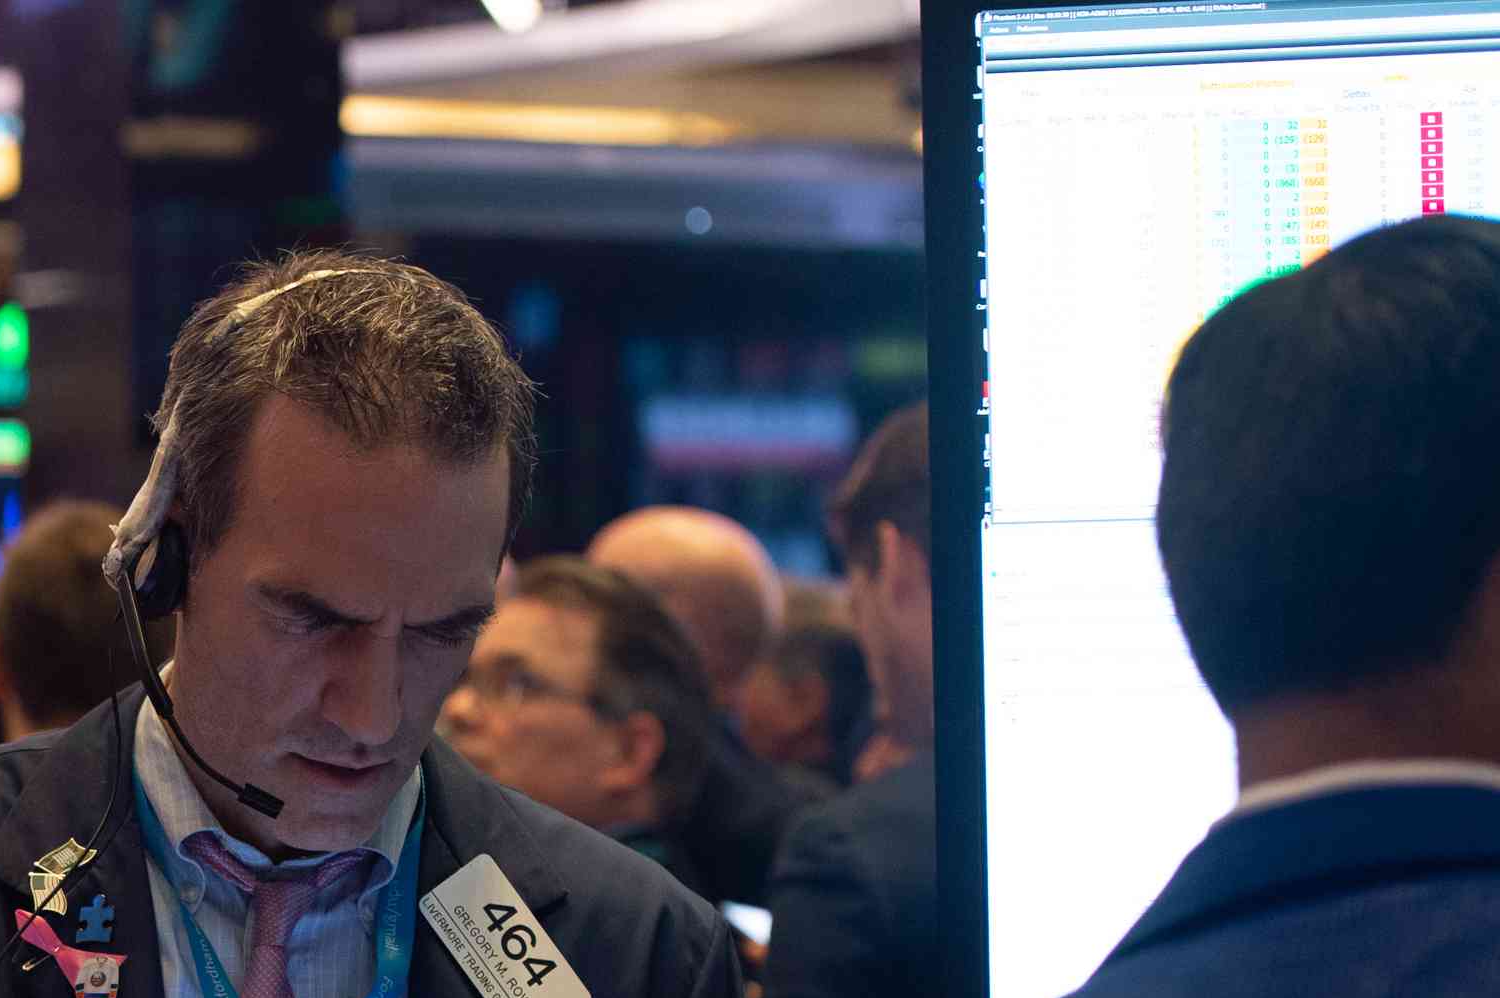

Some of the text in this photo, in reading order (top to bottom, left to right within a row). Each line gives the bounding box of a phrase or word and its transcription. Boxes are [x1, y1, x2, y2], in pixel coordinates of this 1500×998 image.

[424, 897, 466, 953] LIVERMORE
[463, 951, 494, 993] TRADING
[454, 905, 498, 959] GREGORY
[494, 961, 508, 979] M.
[483, 903, 557, 987] 464
